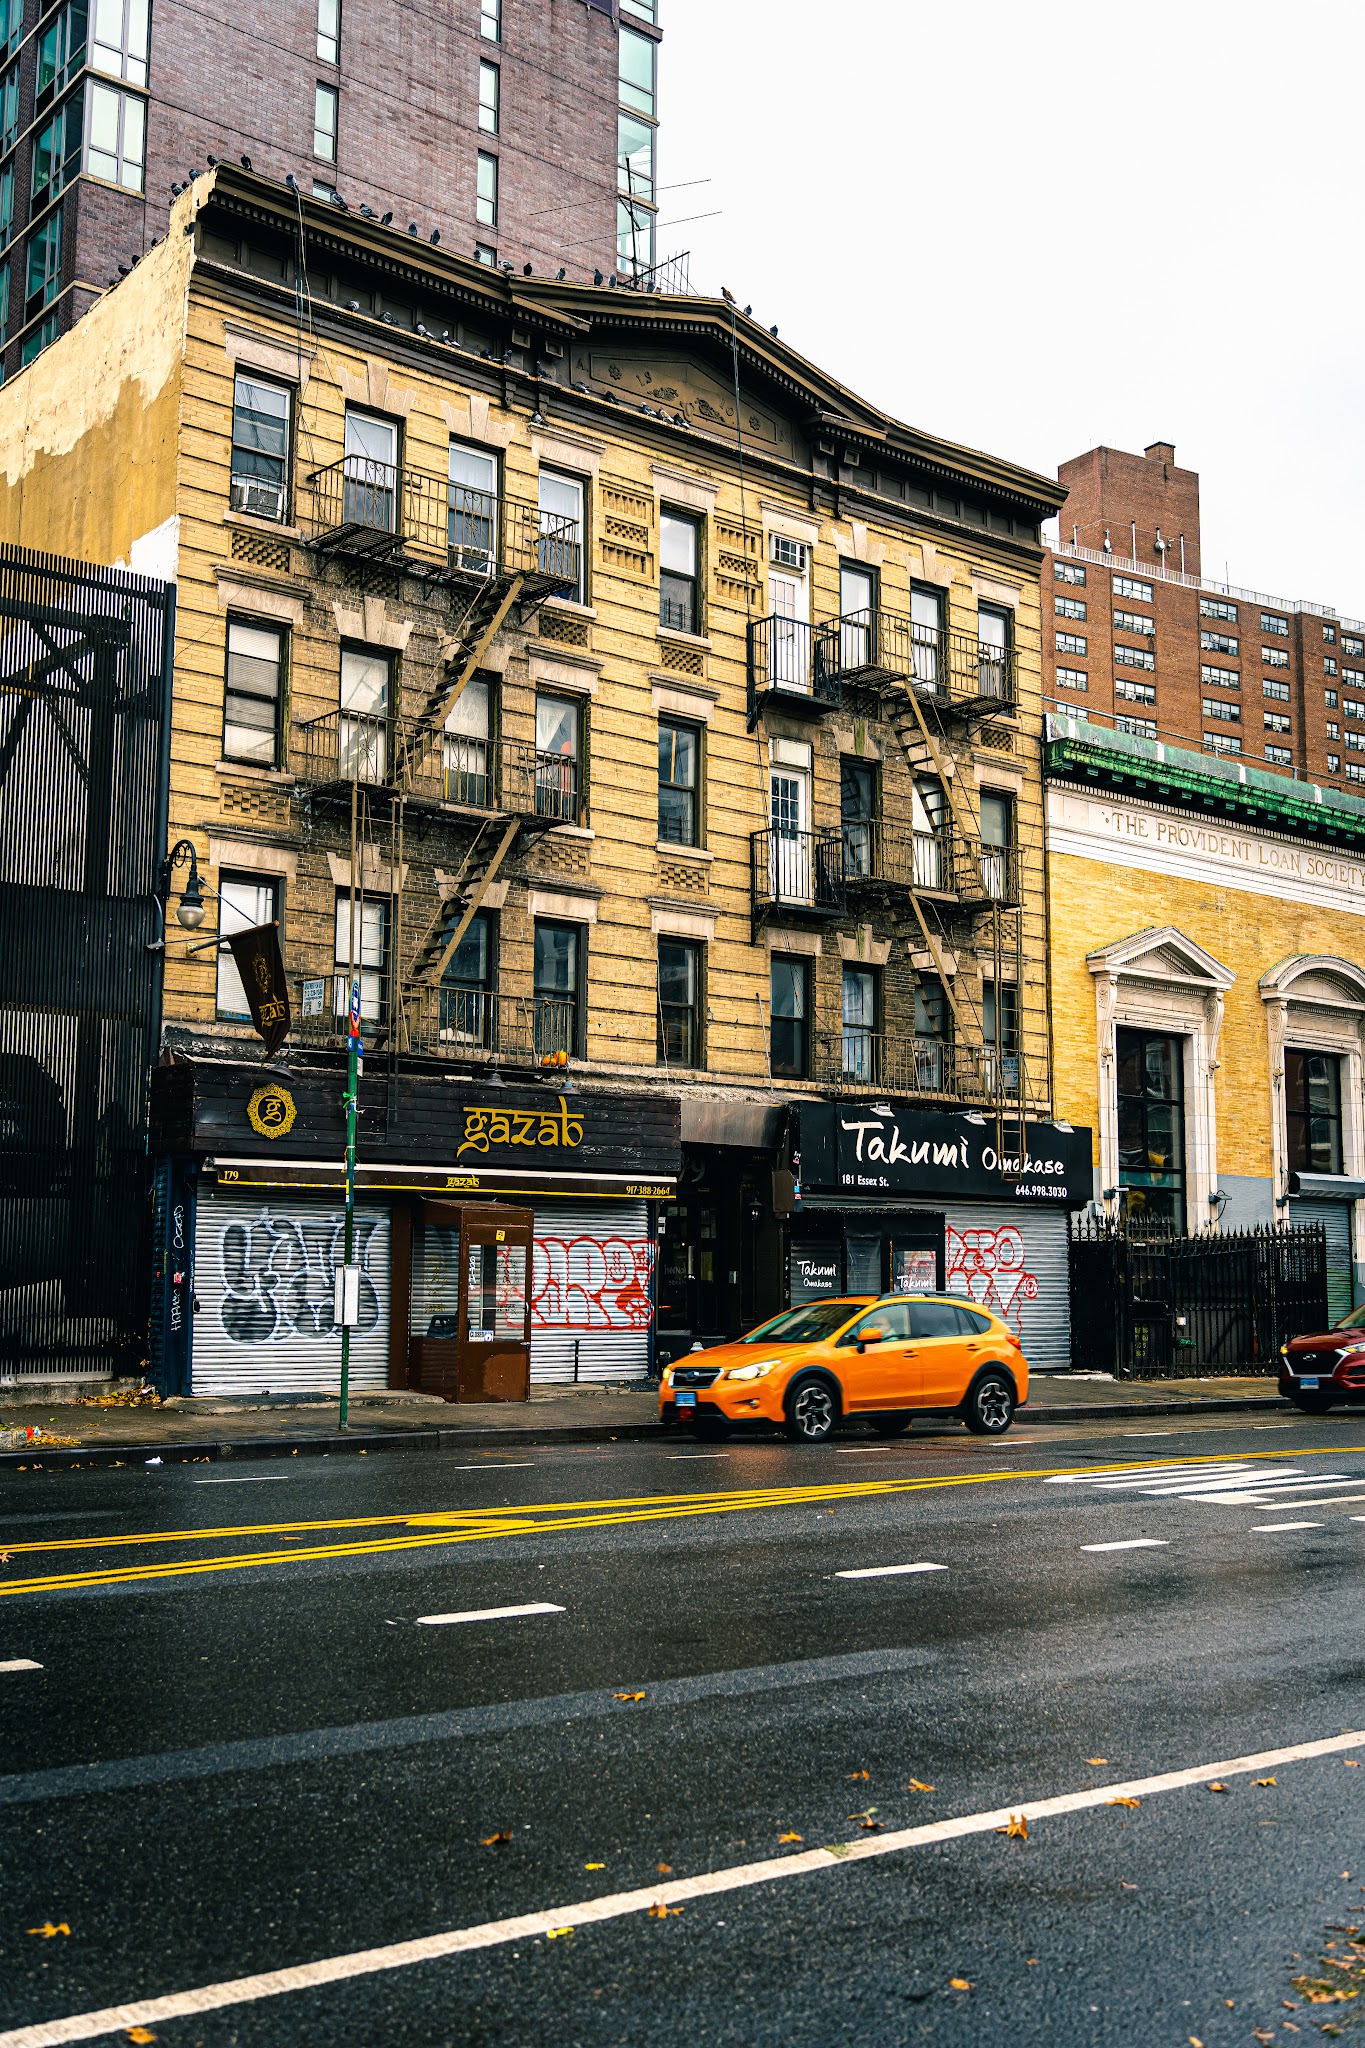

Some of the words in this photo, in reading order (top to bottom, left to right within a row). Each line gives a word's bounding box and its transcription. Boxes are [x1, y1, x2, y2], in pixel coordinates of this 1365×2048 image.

[1112, 811, 1149, 838] THE
[1157, 822, 1252, 861] PROVIDENT
[1258, 845, 1301, 874] LOAN
[456, 1095, 585, 1158] gazab
[841, 1119, 970, 1169] Takumi
[981, 1146, 1065, 1176] Omakase
[224, 1170, 239, 1181] 179
[446, 1174, 480, 1188] gazab
[841, 1174, 855, 1185] 181
[857, 1175, 877, 1187] Essex
[879, 1176, 890, 1188] St.
[625, 1185, 671, 1196] 917-388-2664
[1015, 1184, 1067, 1198] 646.998.3030
[796, 1260, 837, 1277] Takumi
[803, 1278, 833, 1288] Omakase
[896, 1274, 933, 1289] Takumi
